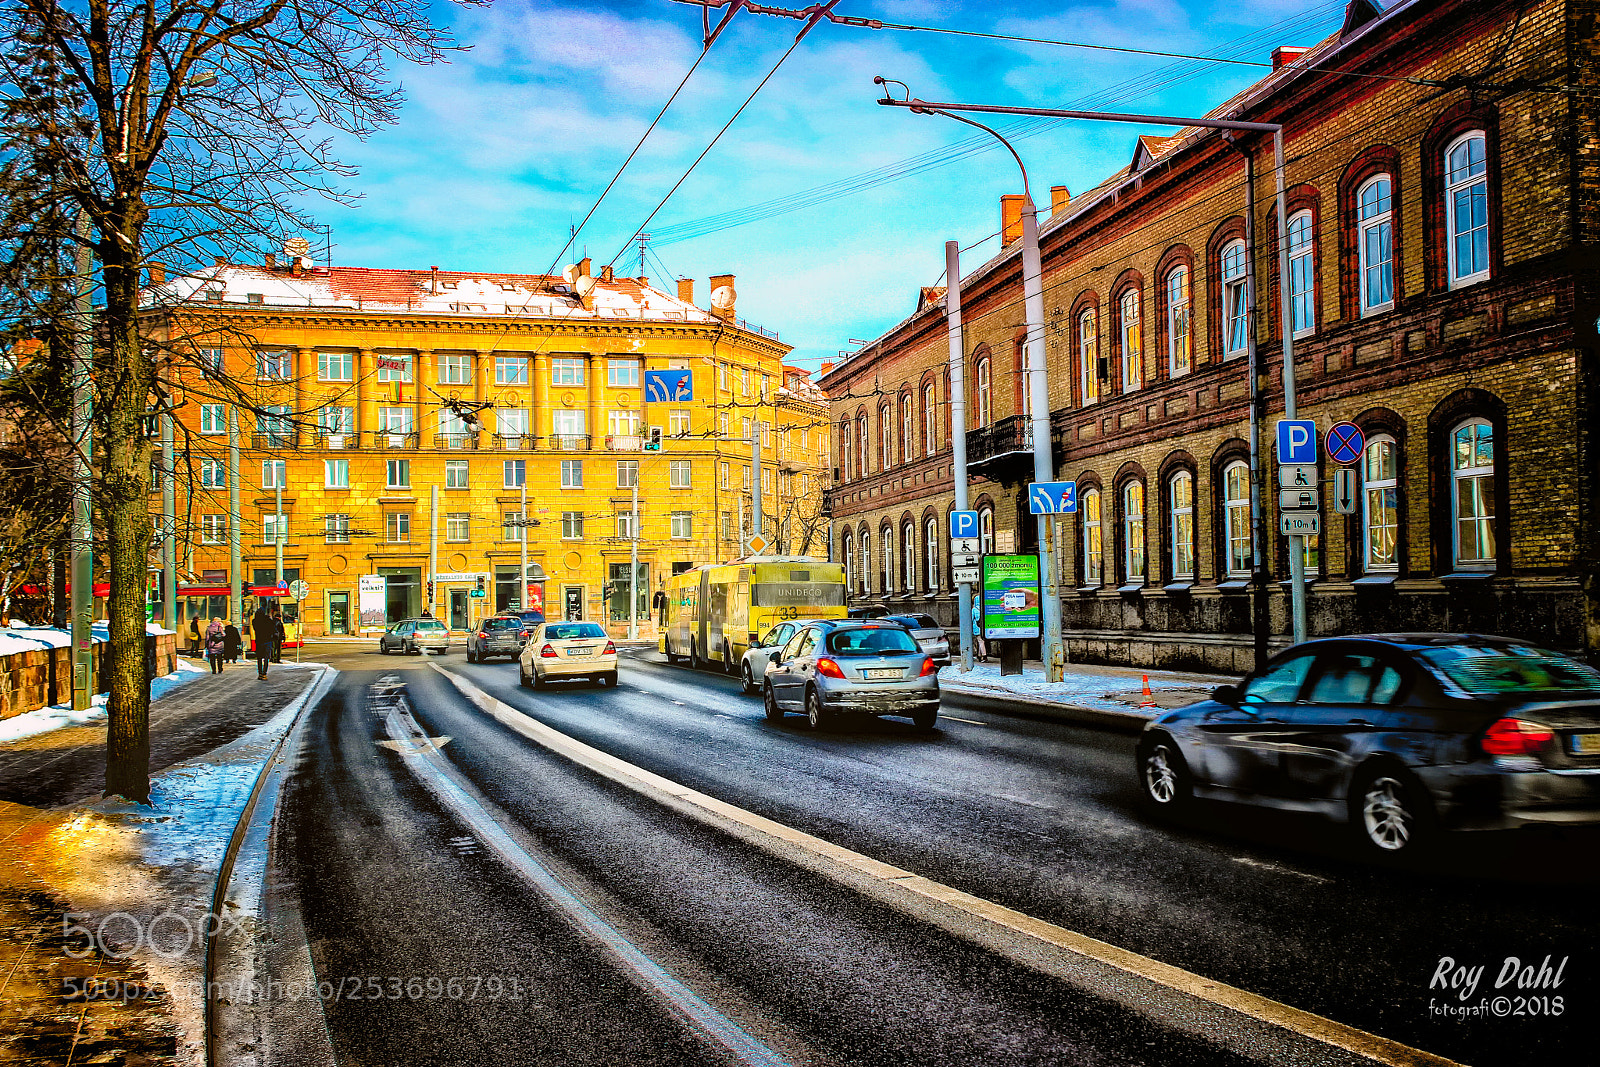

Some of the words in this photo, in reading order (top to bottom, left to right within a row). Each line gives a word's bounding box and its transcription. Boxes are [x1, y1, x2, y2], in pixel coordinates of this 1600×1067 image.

[1288, 425, 1309, 459] P
[958, 514, 973, 535] P
[778, 588, 822, 597] UNIDECO
[779, 606, 798, 620] 33
